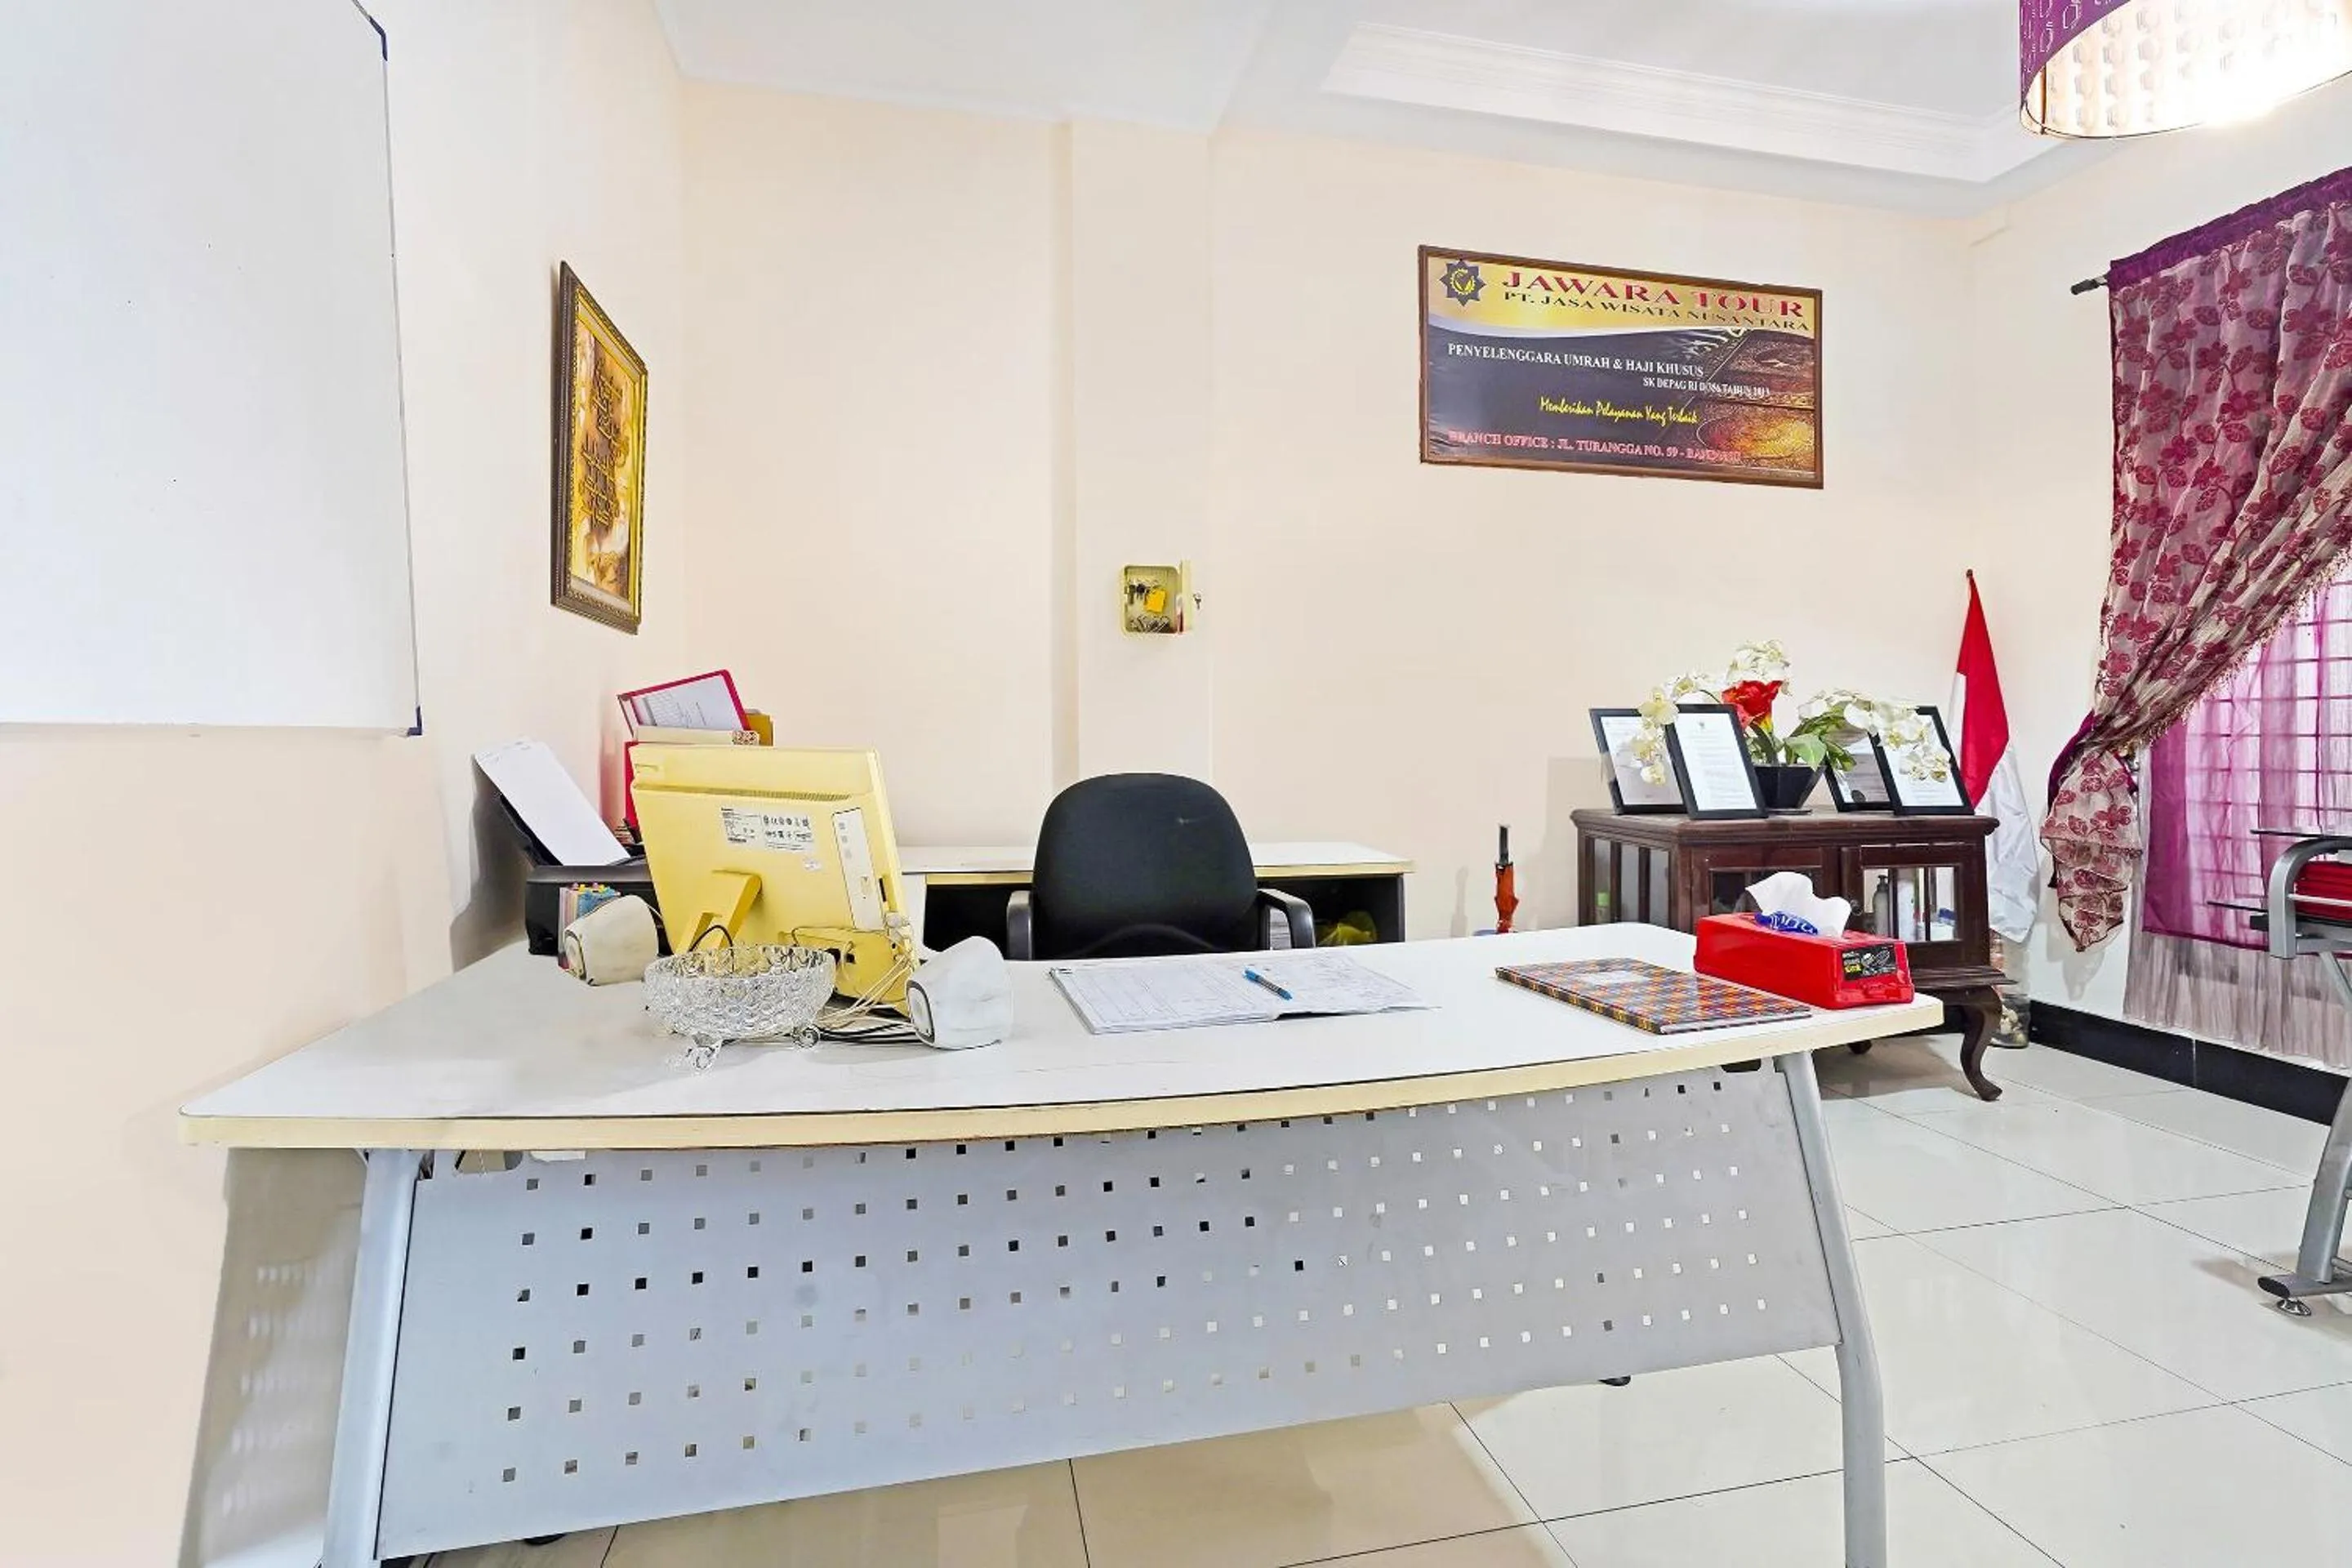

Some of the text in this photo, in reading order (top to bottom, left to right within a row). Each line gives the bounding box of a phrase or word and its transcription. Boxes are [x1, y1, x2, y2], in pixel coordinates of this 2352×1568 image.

[1502, 272, 1803, 317] JAWARA TOUR
[1504, 292, 1810, 331] PT. JASA WISATA NUSANTARA
[1448, 343, 1704, 377] PENYELENGGARA UMRAH & HAJI KHUSUS
[1643, 377, 1655, 387] SK
[1657, 378, 1686, 390] DEPAG
[1688, 381, 1698, 390] RI
[1539, 395, 1698, 426] Memberikan Pelayanan Yang Terbaik
[1448, 430, 1501, 445] BRANCH
[1503, 434, 1548, 448] OFFICE
[1576, 440, 1643, 456] TURANGGA
